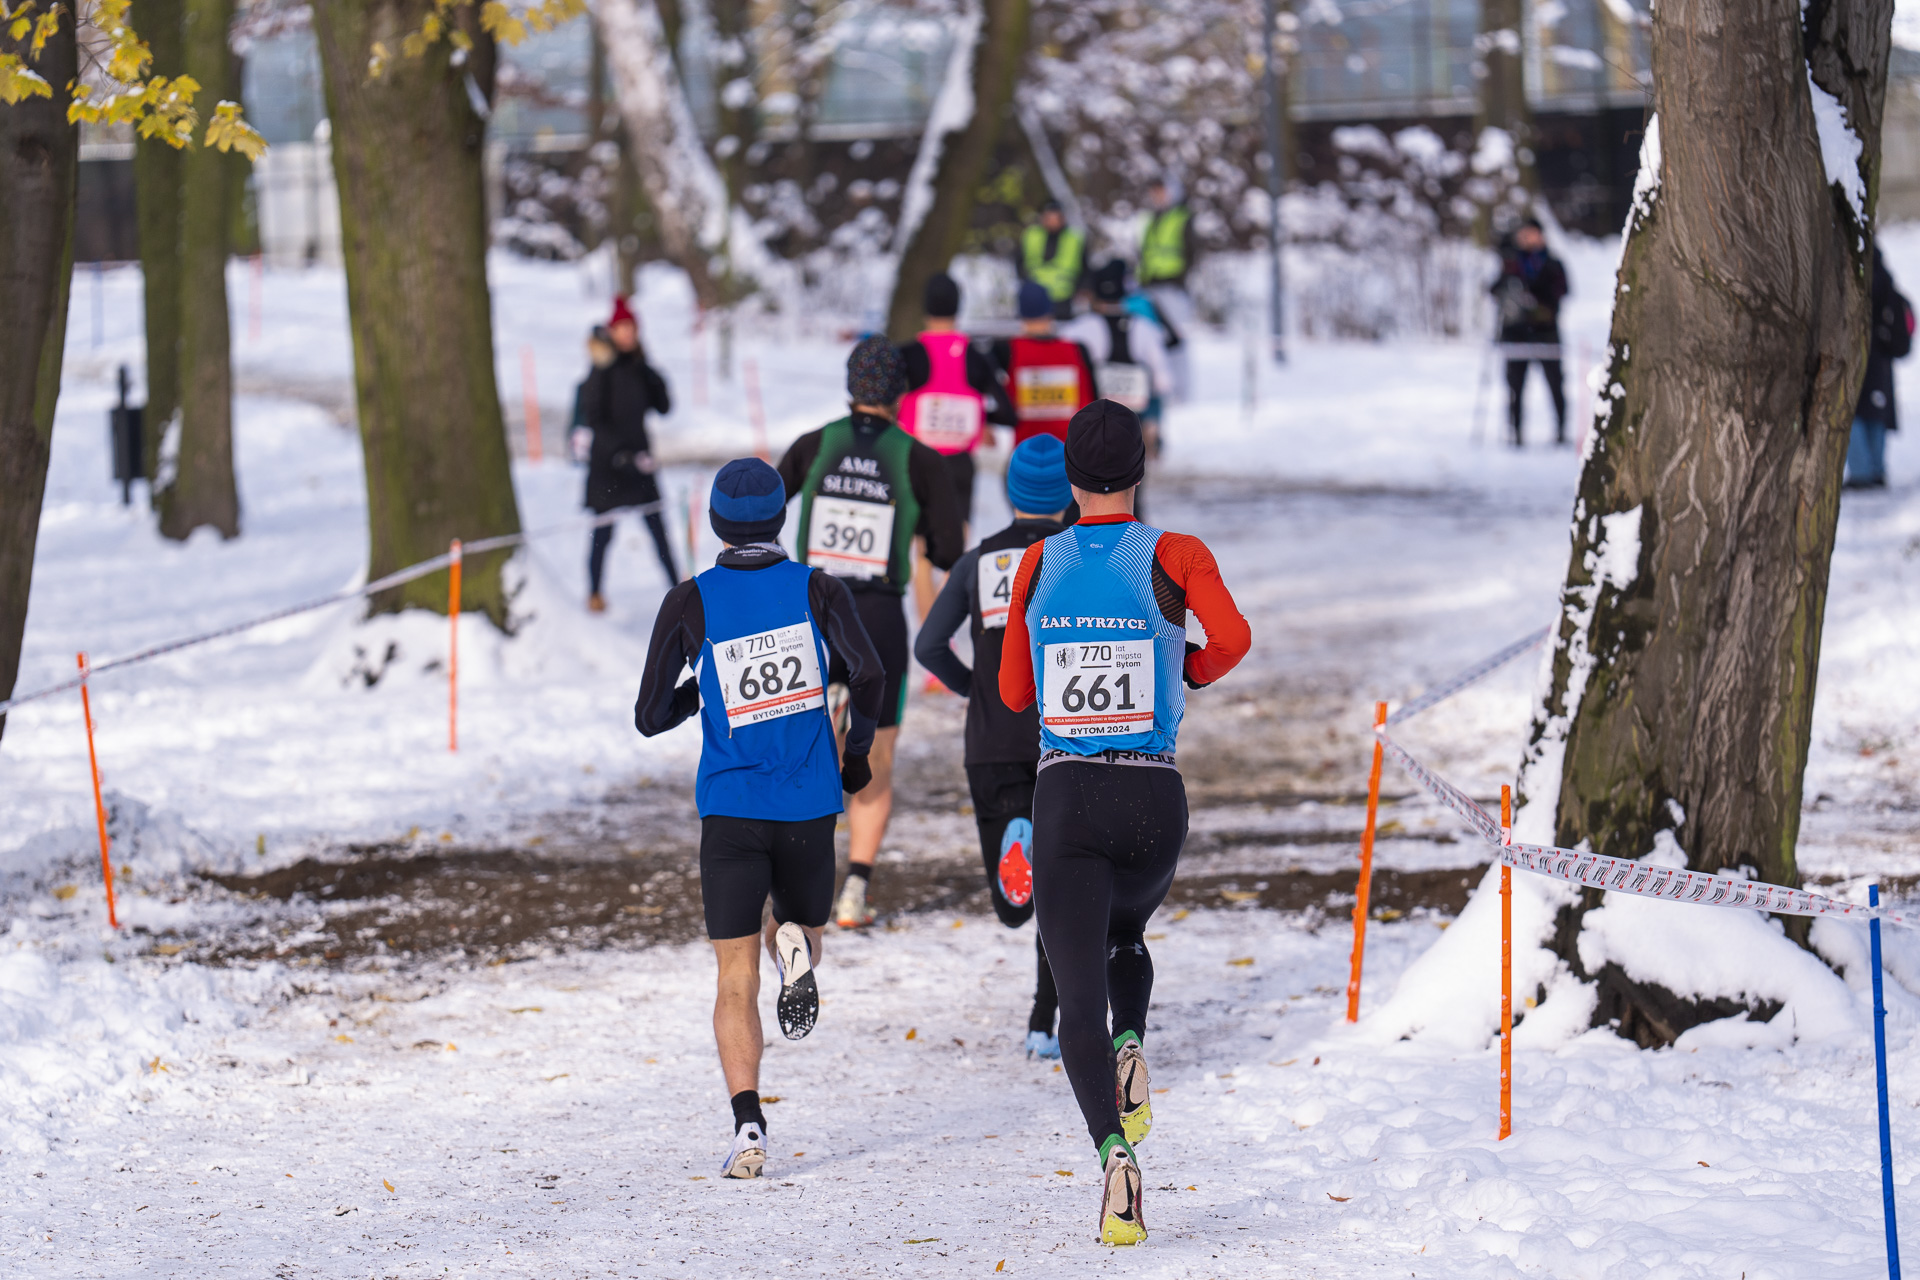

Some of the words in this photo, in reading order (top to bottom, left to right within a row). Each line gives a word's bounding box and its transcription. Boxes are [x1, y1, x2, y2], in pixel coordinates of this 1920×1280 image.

[838, 456, 880, 477] AML
[822, 522, 875, 554] 390
[1040, 615, 1072, 629] ŻAK
[1075, 616, 1147, 631] PYRZYCE
[745, 634, 776, 654] 770
[777, 630, 787, 638] lat
[780, 643, 804, 654] Bytom
[1080, 645, 1112, 662] 770
[1115, 652, 1142, 660] miasta
[1116, 661, 1141, 669] Bytom
[739, 656, 807, 701] 682
[1062, 673, 1136, 713] 661
[752, 705, 784, 721] BYTOM
[785, 702, 807, 714] 2024
[1070, 727, 1105, 735] BYTOM
[1107, 725, 1130, 733] 2024
